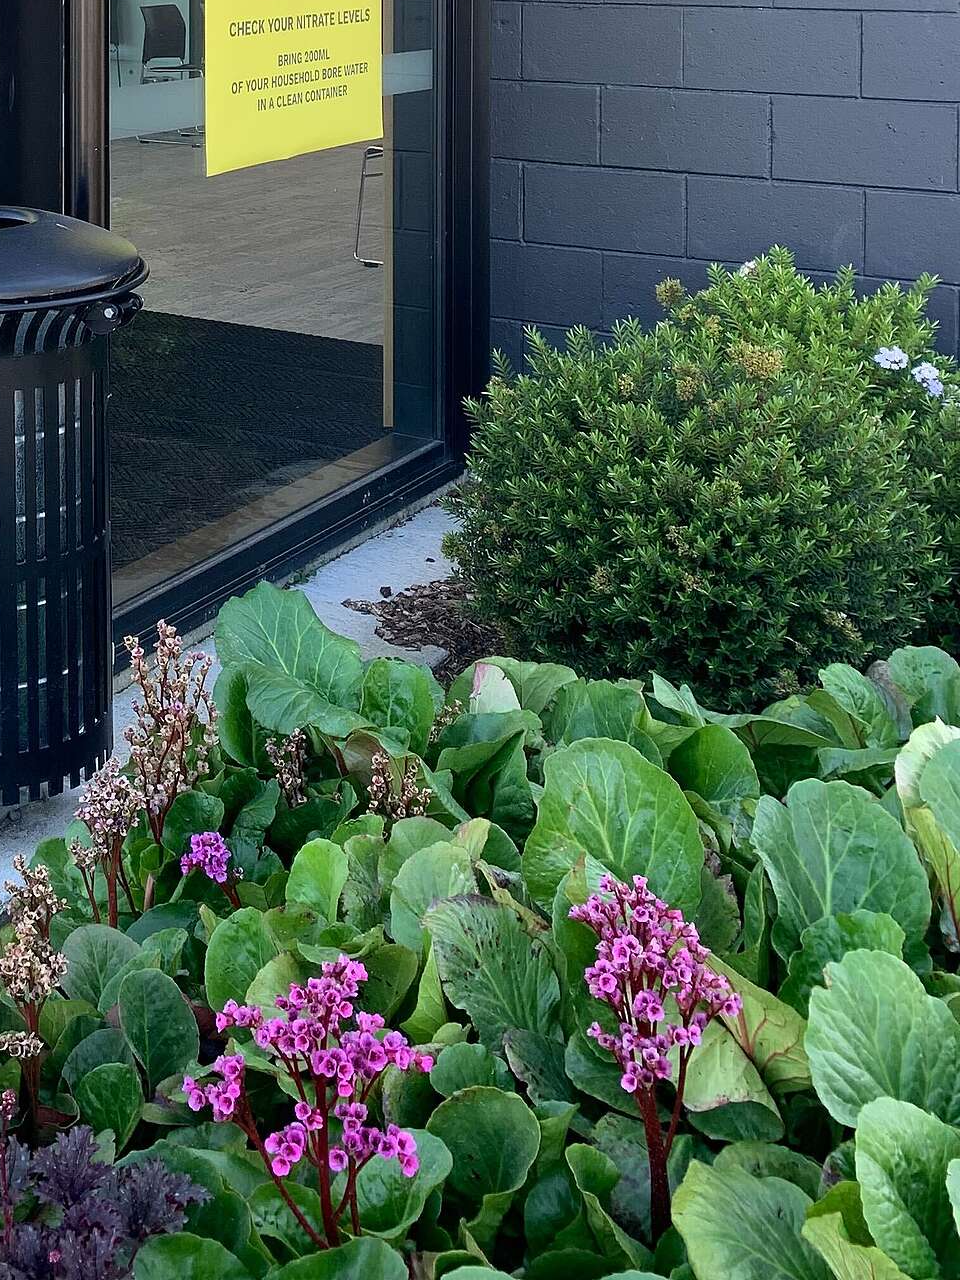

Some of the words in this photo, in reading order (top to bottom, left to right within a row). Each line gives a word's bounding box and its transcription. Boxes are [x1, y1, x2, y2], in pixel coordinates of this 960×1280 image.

[229, 19, 265, 37] CHECK
[268, 16, 294, 33] YOUR
[296, 12, 335, 29] NITRATE
[338, 8, 370, 25] LEVELS
[278, 52, 302, 67] BRING
[304, 48, 330, 63] 200ML
[231, 81, 244, 94] OF
[245, 77, 269, 92] YOUR
[271, 69, 320, 88] HOUSEHOLD
[322, 66, 342, 80] BORE
[344, 62, 368, 76] WATER
[258, 98, 266, 111] IN
[269, 97, 275, 109] A
[276, 92, 303, 108] CLEAN
[305, 84, 348, 103] CONTAINER
